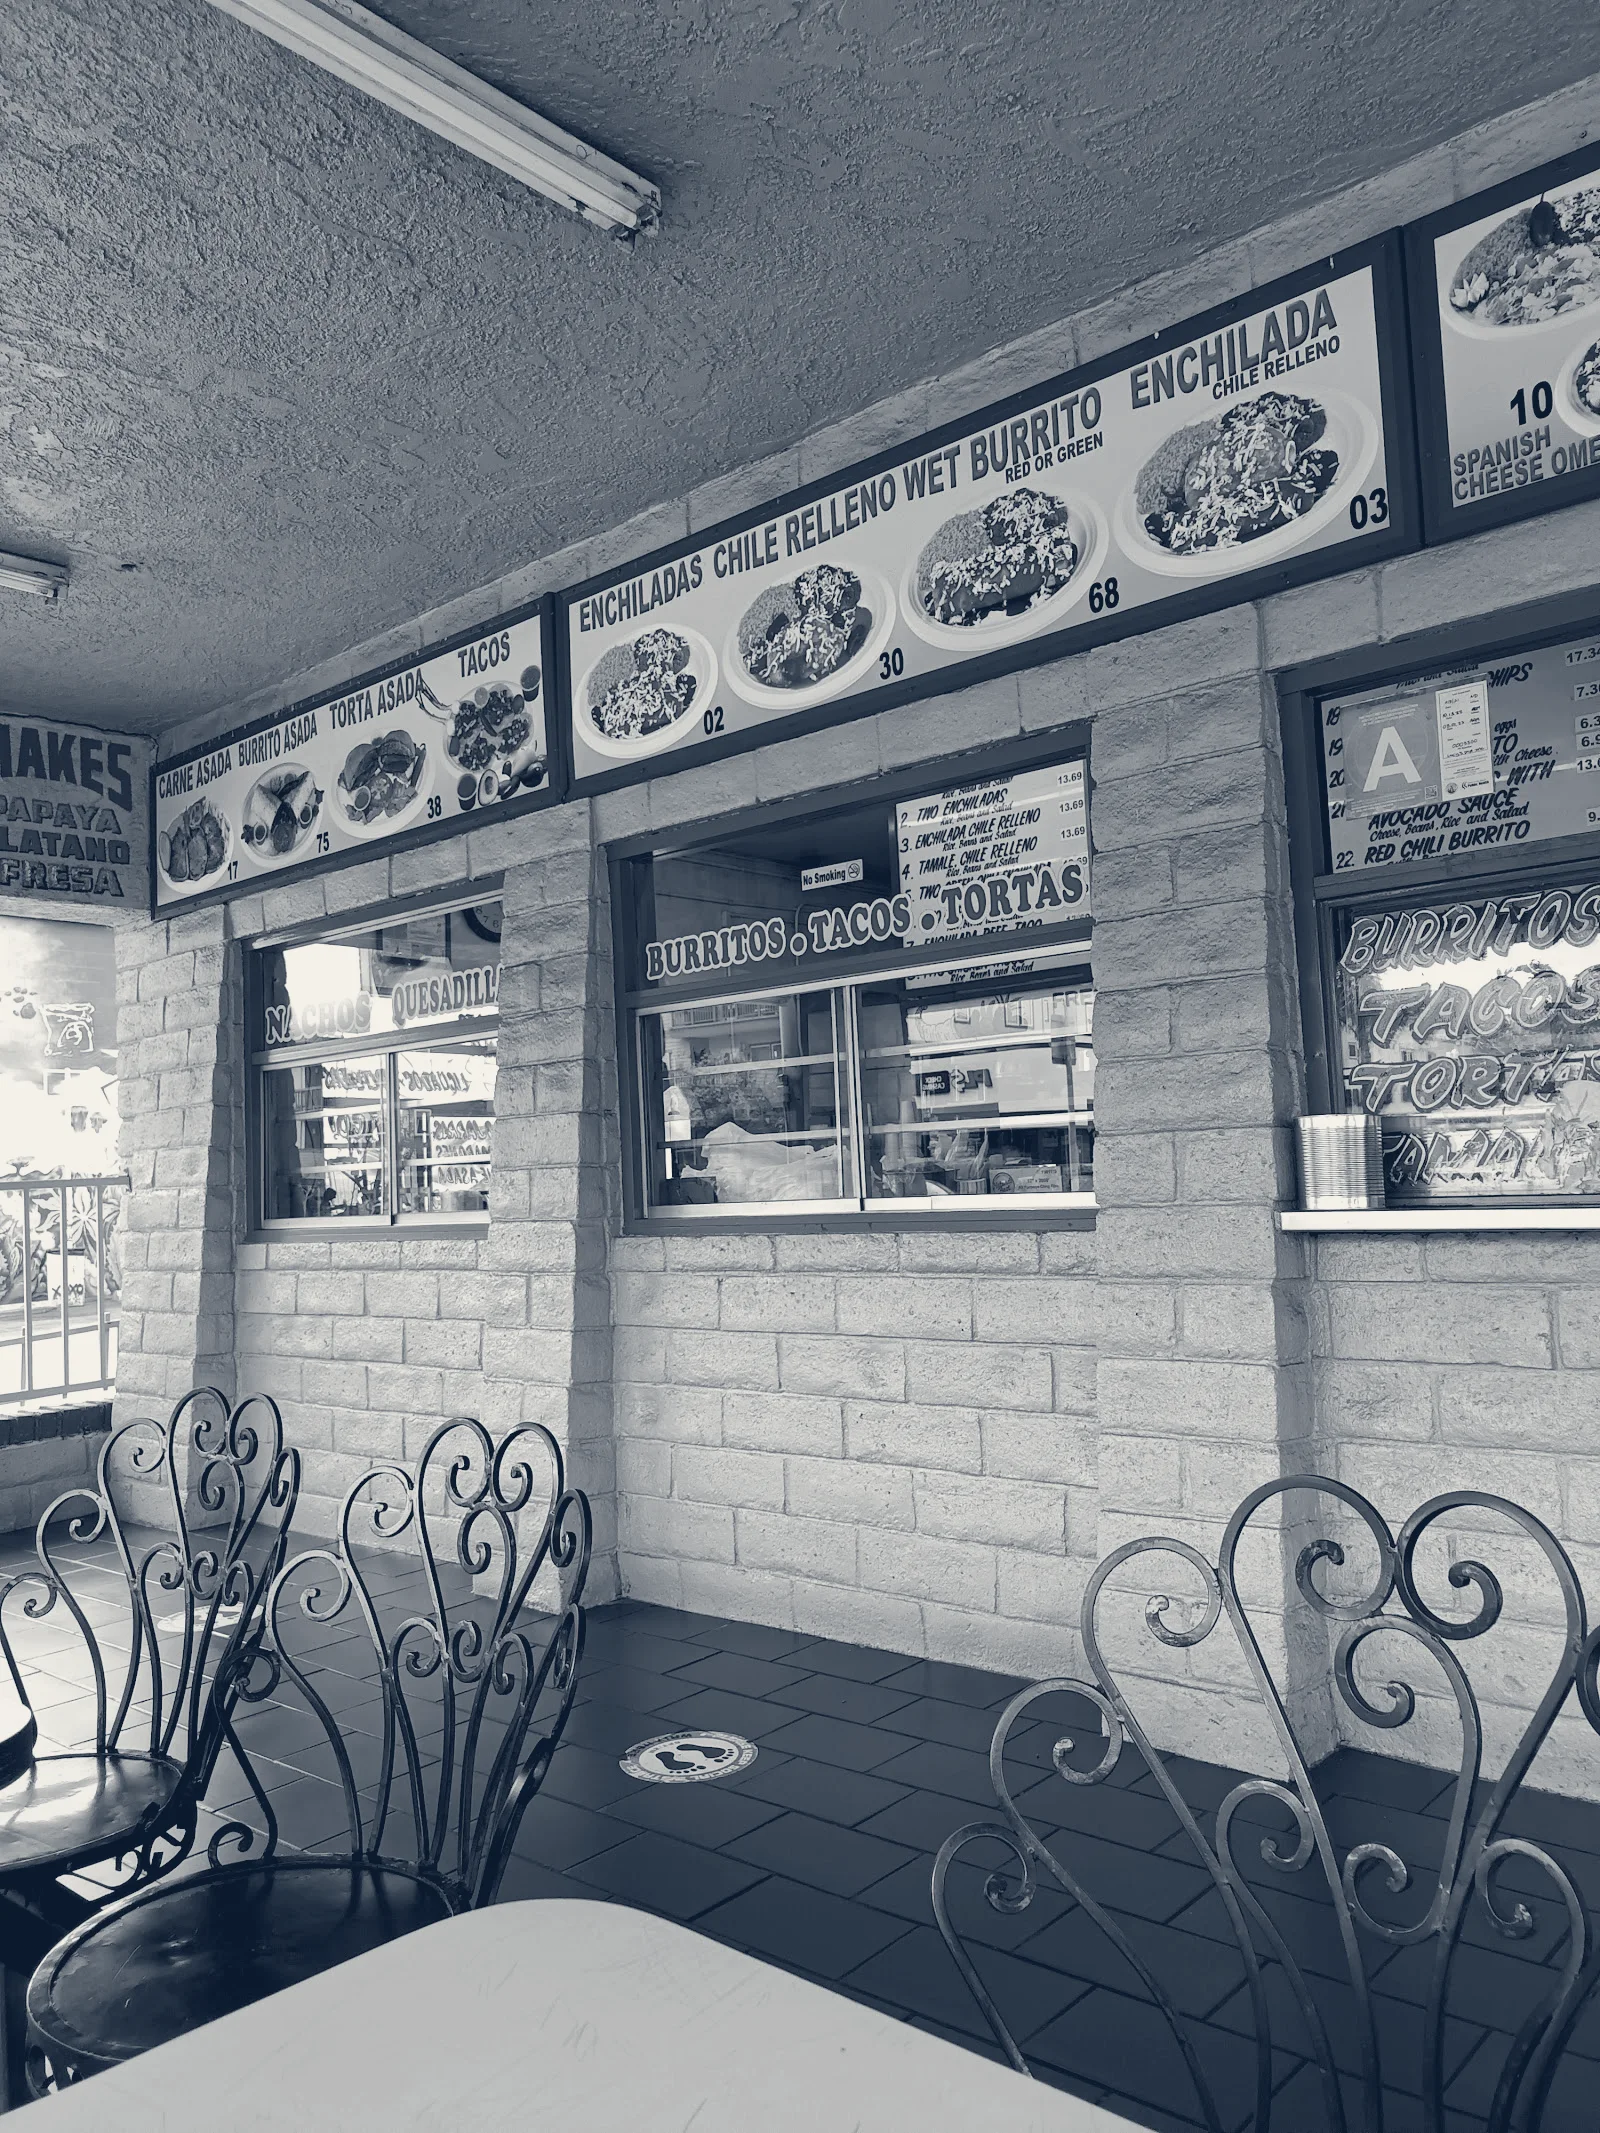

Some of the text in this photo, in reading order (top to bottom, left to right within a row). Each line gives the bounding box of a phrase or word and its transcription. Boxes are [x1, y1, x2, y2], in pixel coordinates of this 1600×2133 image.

[1130, 288, 1338, 410] ENCHILADA
[1212, 335, 1341, 400] CHILE RELLENO
[1510, 381, 1553, 426] 10
[902, 386, 1102, 502] WET BURRITO
[1005, 431, 1104, 484] RED OR GREEN
[1453, 424, 1551, 477] SPANISH
[1454, 454, 1544, 500] CHEESE
[713, 473, 897, 578] CHILE RELLENO
[1349, 487, 1388, 530] 03
[579, 554, 704, 633] ENCHILADAS
[1088, 576, 1120, 614] 68
[457, 631, 511, 678] TACOS
[879, 647, 904, 680] 30
[329, 667, 423, 729] TORTA ASADA
[1576, 683, 1600, 698] 7.3
[238, 712, 318, 767] BURRITO ASADA
[703, 705, 725, 735] 02
[1328, 738, 1343, 756] 19
[1363, 726, 1422, 793] A
[159, 748, 232, 799] CARNE ASADA
[1057, 771, 1082, 785] 13.69
[1507, 760, 1556, 786] WITH
[427, 795, 442, 819] 38
[917, 804, 939, 822] TWO
[943, 788, 1008, 816] ENCHILADAS
[968, 818, 997, 838] CHILE
[997, 808, 1041, 831] RELLENO
[1059, 799, 1084, 813] 13.69
[1368, 801, 1450, 830] AVOCADO
[1457, 788, 1519, 814] SAUCE
[1441, 816, 1461, 829] Rice
[1466, 810, 1488, 824] and
[1492, 801, 1530, 821] Salad
[316, 832, 330, 853] 75
[960, 847, 989, 866] CHILE
[990, 836, 1038, 860] RELLENO
[979, 833, 993, 843] and
[1060, 826, 1086, 840] 13.69
[1364, 843, 1396, 865] RED
[1400, 834, 1445, 859] CHILI
[1448, 820, 1531, 850] BURRITO
[0, 858, 124, 897] FRESA
[227, 861, 238, 880] 17
[803, 869, 846, 885] No Smoking
[984, 860, 997, 870] and
[919, 884, 941, 900] TWO
[939, 861, 1087, 926] TORTAS
[483, 915, 489, 923] 7
[808, 893, 914, 953] TACOS
[1340, 883, 1600, 974] BURRITOS
[646, 917, 786, 980] BURRITOS
[265, 990, 372, 1044] NACHOS
[392, 963, 501, 1029] QUESADILL
[1360, 964, 1600, 1048] TACOS
[690, 1764, 740, 1780] SOCIAL
